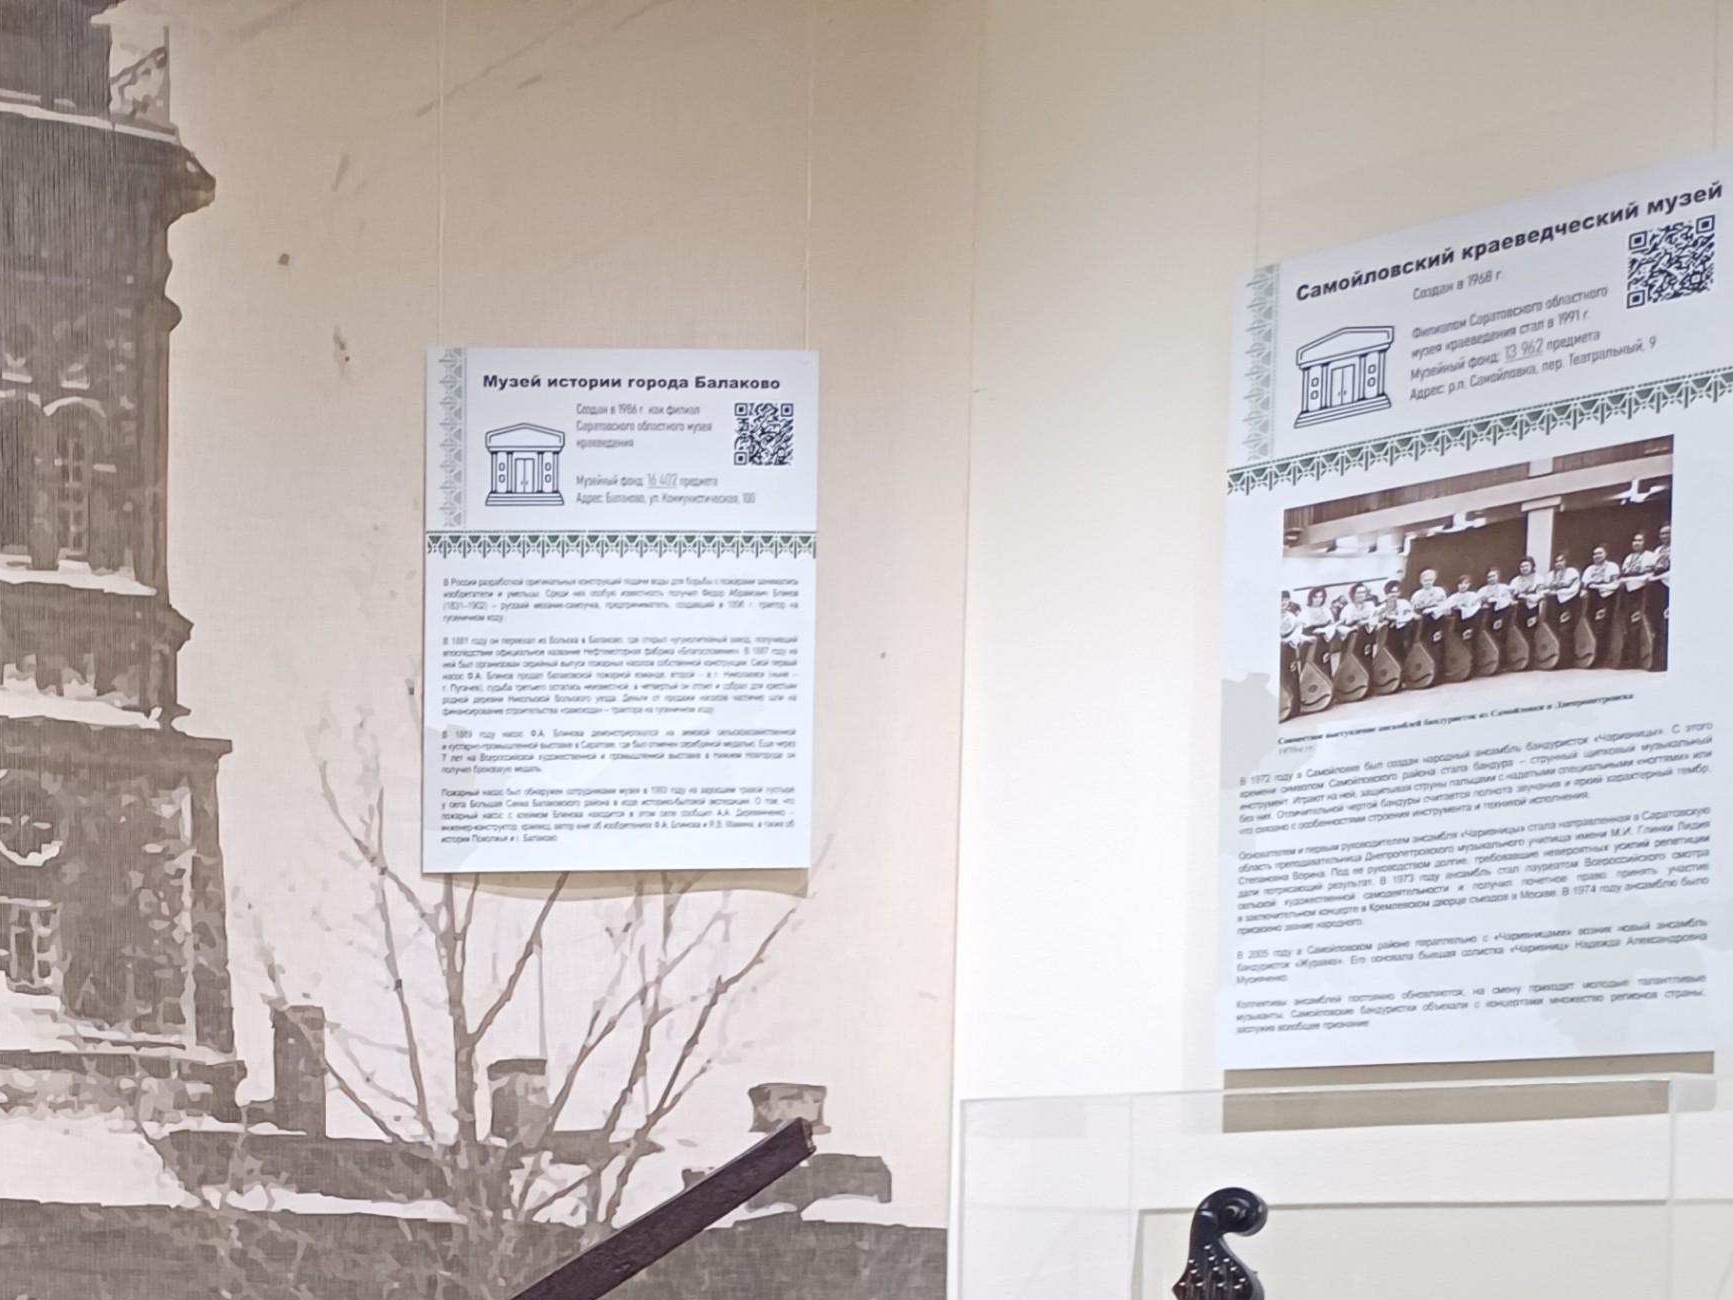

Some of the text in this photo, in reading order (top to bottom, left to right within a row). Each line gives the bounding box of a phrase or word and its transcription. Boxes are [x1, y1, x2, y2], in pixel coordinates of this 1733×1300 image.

[1295, 181, 1723, 301] Самойловский краеведческий музей
[1412, 282, 1454, 300] Создан
[1466, 269, 1493, 286] 1968
[1410, 342, 1443, 360] музея
[1444, 325, 1517, 352] краеведения
[1518, 319, 1545, 335] стал
[1557, 308, 1580, 325] 1991
[1411, 285, 1608, 339] Филиалом Саратовского областного
[1409, 356, 1466, 381] Музейный
[1520, 338, 1544, 355] 962
[1545, 330, 1601, 352] предмета
[1447, 379, 1468, 395] р.п.
[1468, 364, 1539, 388] Самойловка,
[1540, 358, 1566, 372] пер.
[1568, 337, 1645, 366] Театральный,
[482, 374, 780, 391] Музей истории города Балаково
